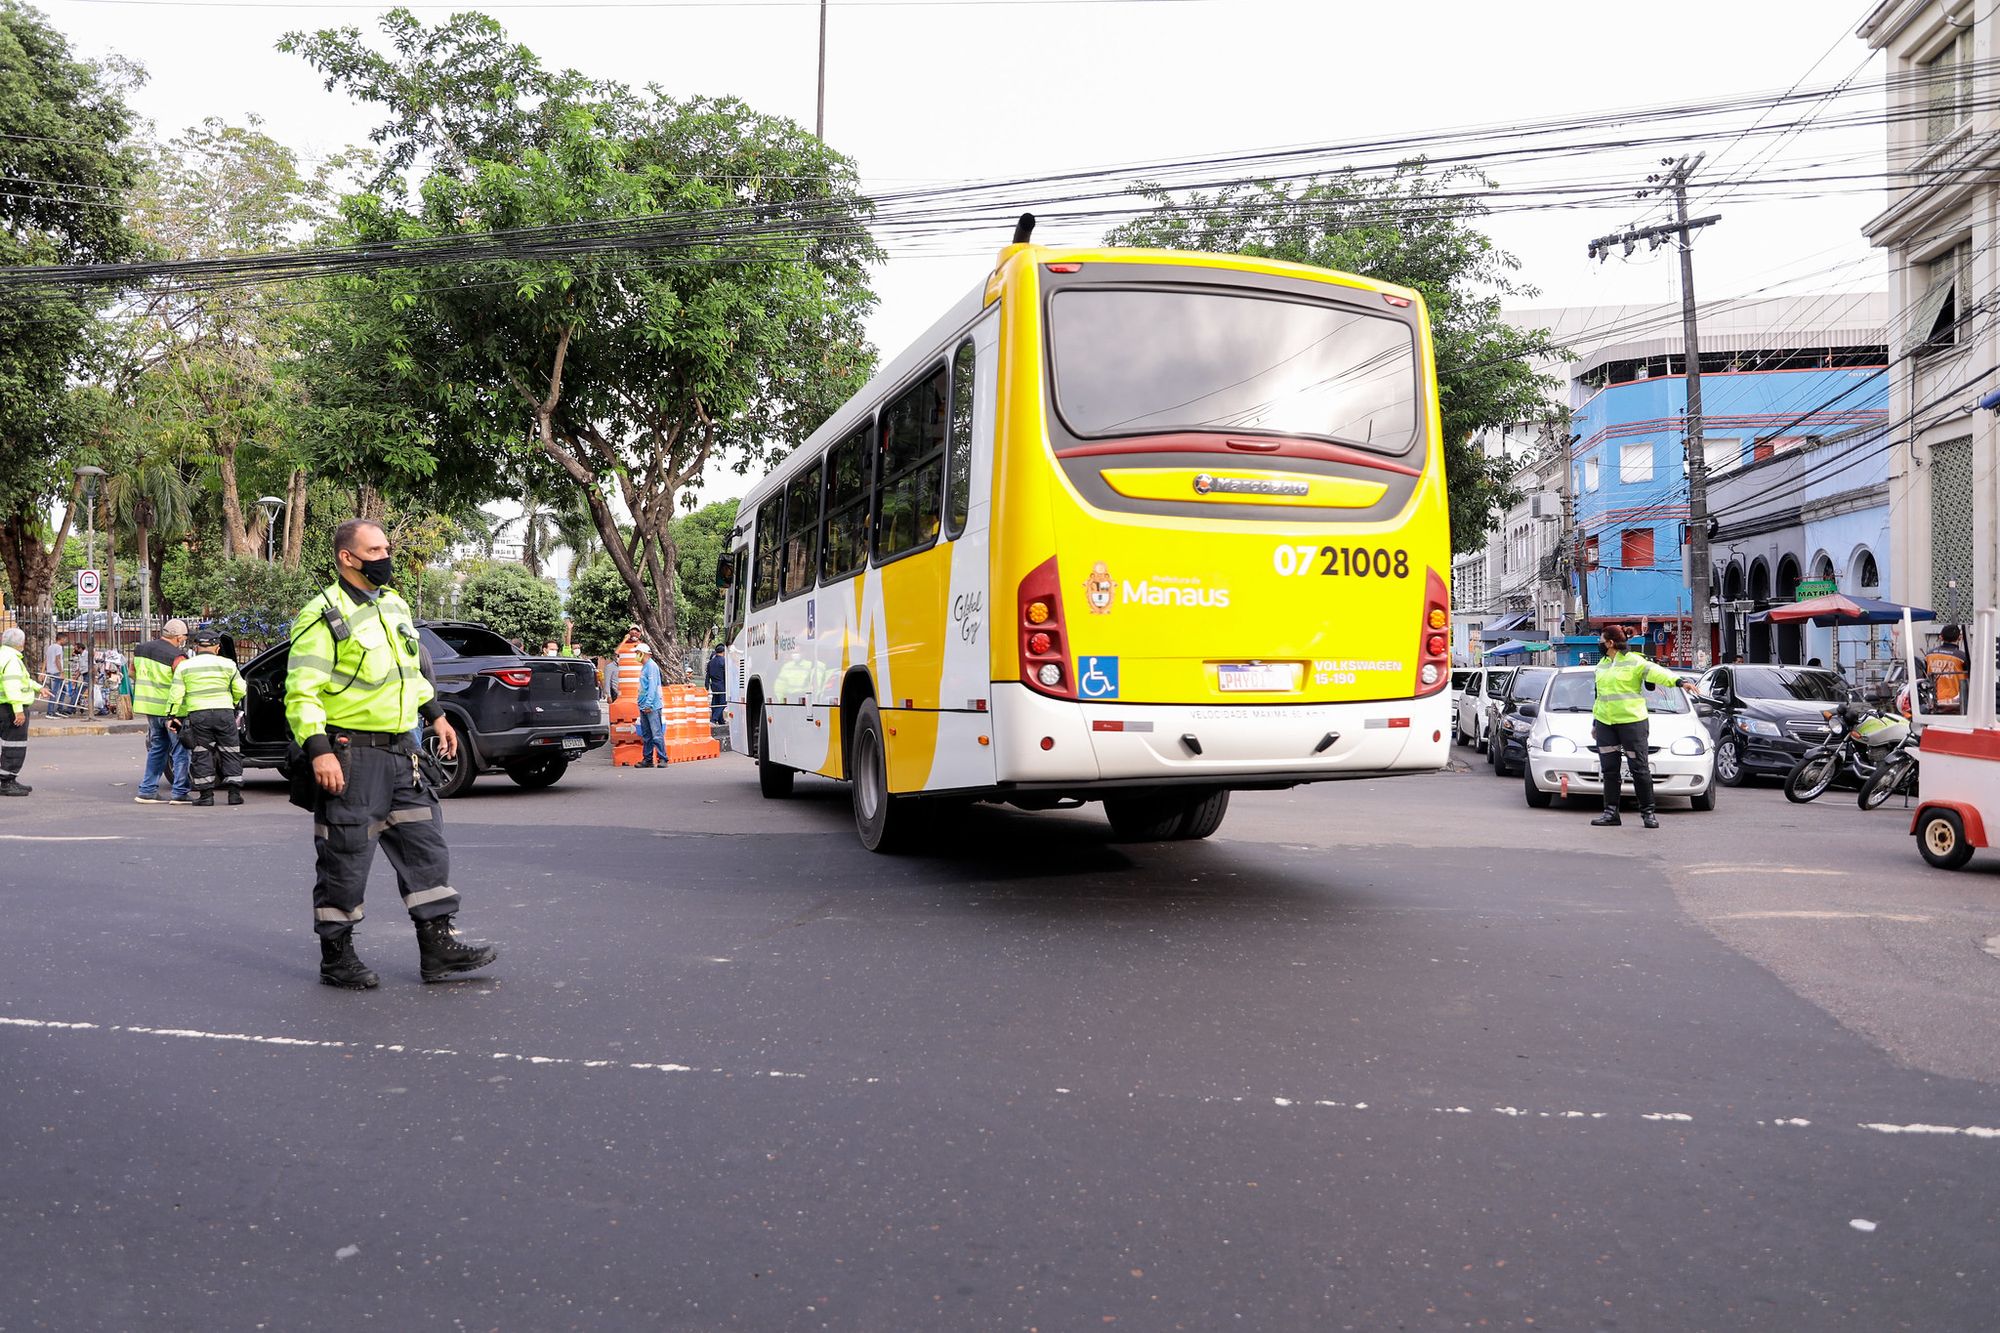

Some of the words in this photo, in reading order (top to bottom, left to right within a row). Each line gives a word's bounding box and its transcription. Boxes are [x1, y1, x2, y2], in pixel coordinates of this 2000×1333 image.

[1122, 579, 1230, 608] Manaus
[1314, 661, 1402, 671] VOLKSWAGEN
[1315, 673, 1355, 684] 15-190
